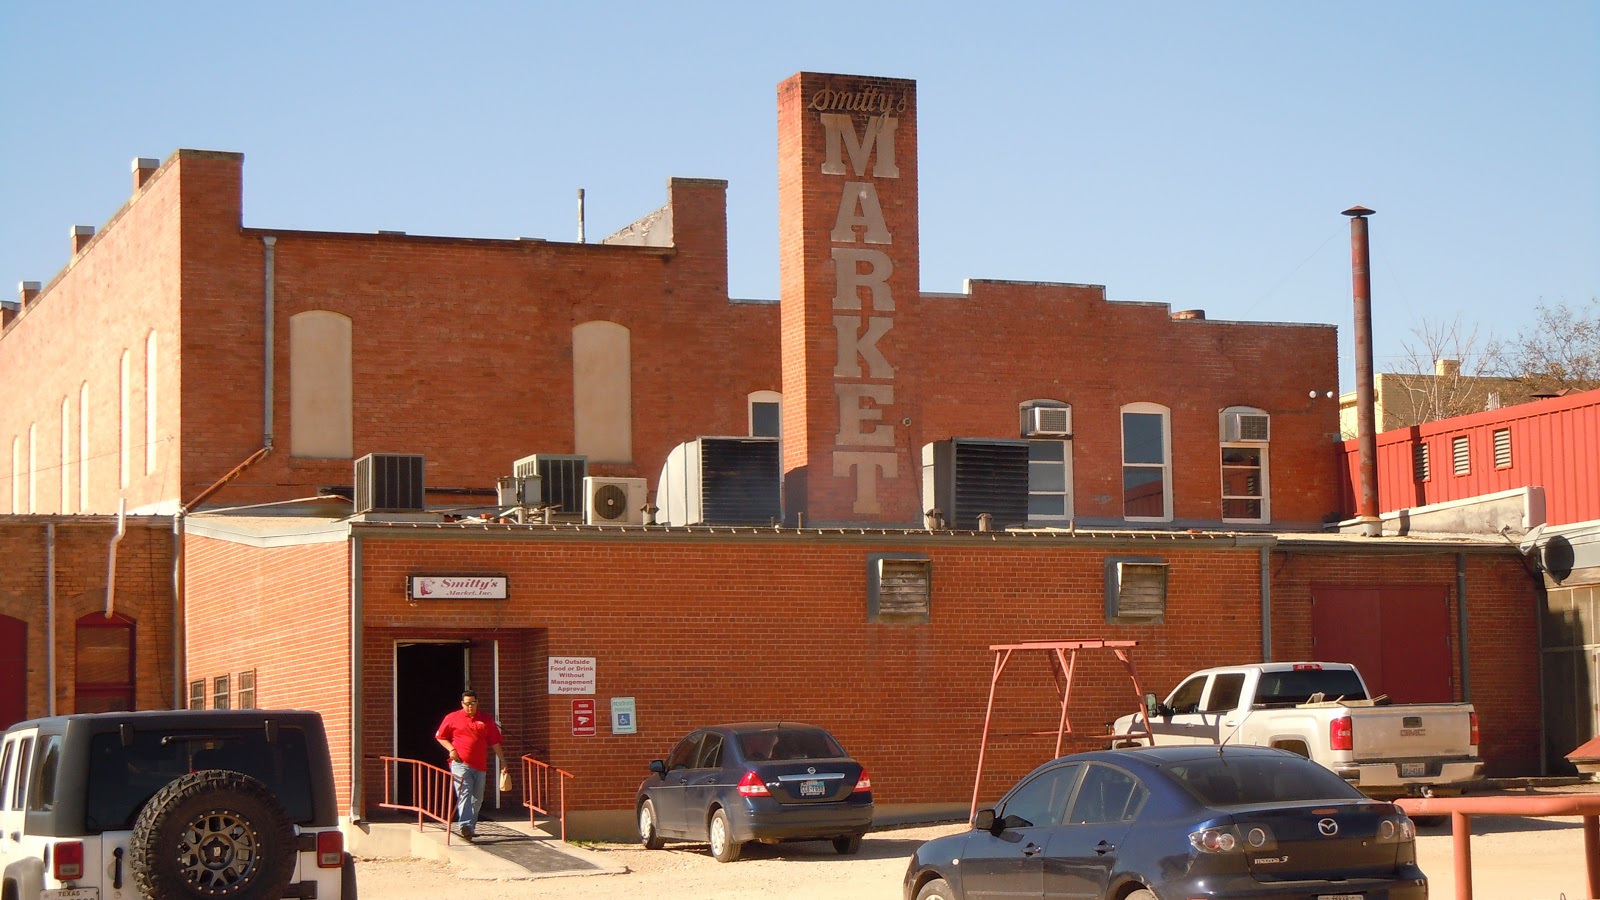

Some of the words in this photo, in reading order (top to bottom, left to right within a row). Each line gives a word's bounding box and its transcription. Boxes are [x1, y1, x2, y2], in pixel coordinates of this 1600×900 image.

[820, 112, 900, 515] MARKET
[440, 578, 499, 590] Smitty's
[1400, 729, 1426, 737] GMC
[1254, 857, 1280, 865] mazda
